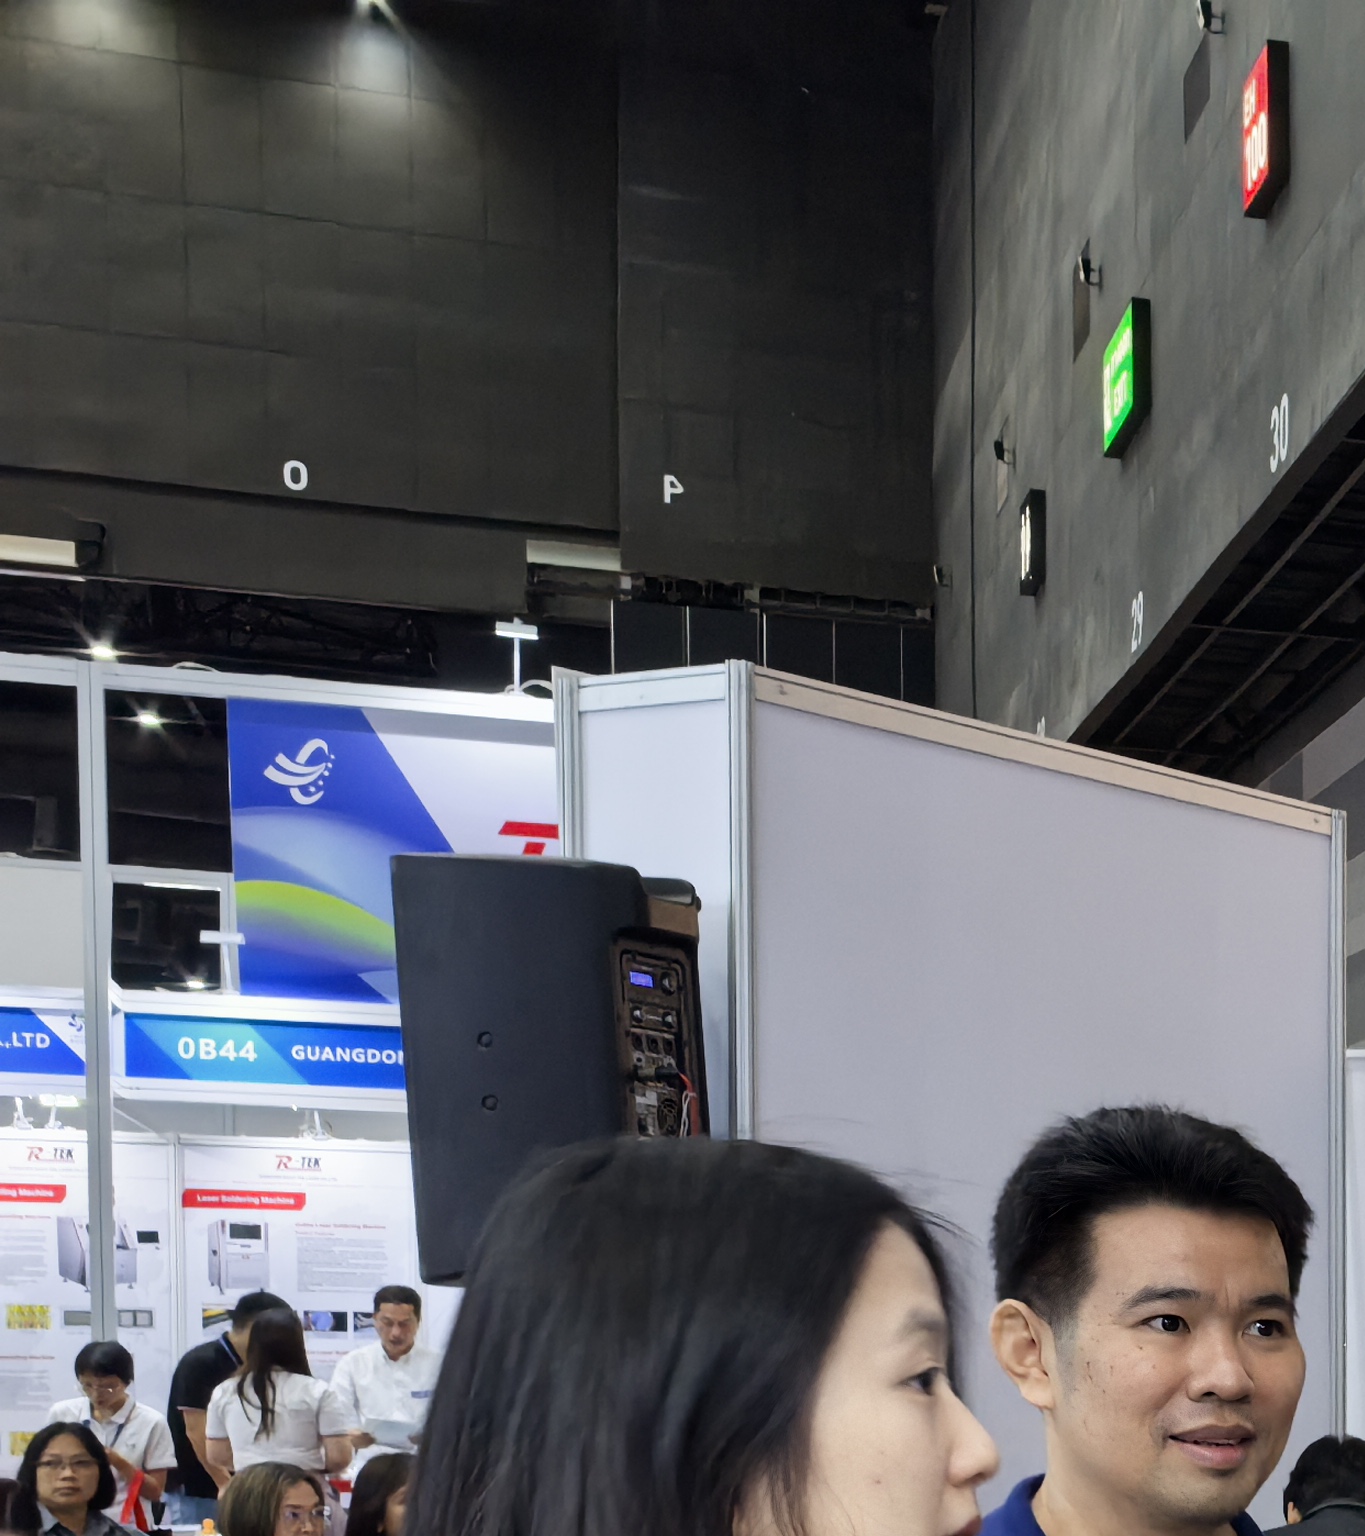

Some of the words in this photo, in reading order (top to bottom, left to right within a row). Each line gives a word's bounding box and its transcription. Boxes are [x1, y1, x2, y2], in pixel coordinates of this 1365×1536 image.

[1244, 79, 1256, 130] EH
[1246, 112, 1269, 192] 100
[1269, 393, 1289, 473] 30
[1131, 591, 1144, 654] 29
[177, 1036, 258, 1063] 0B44
